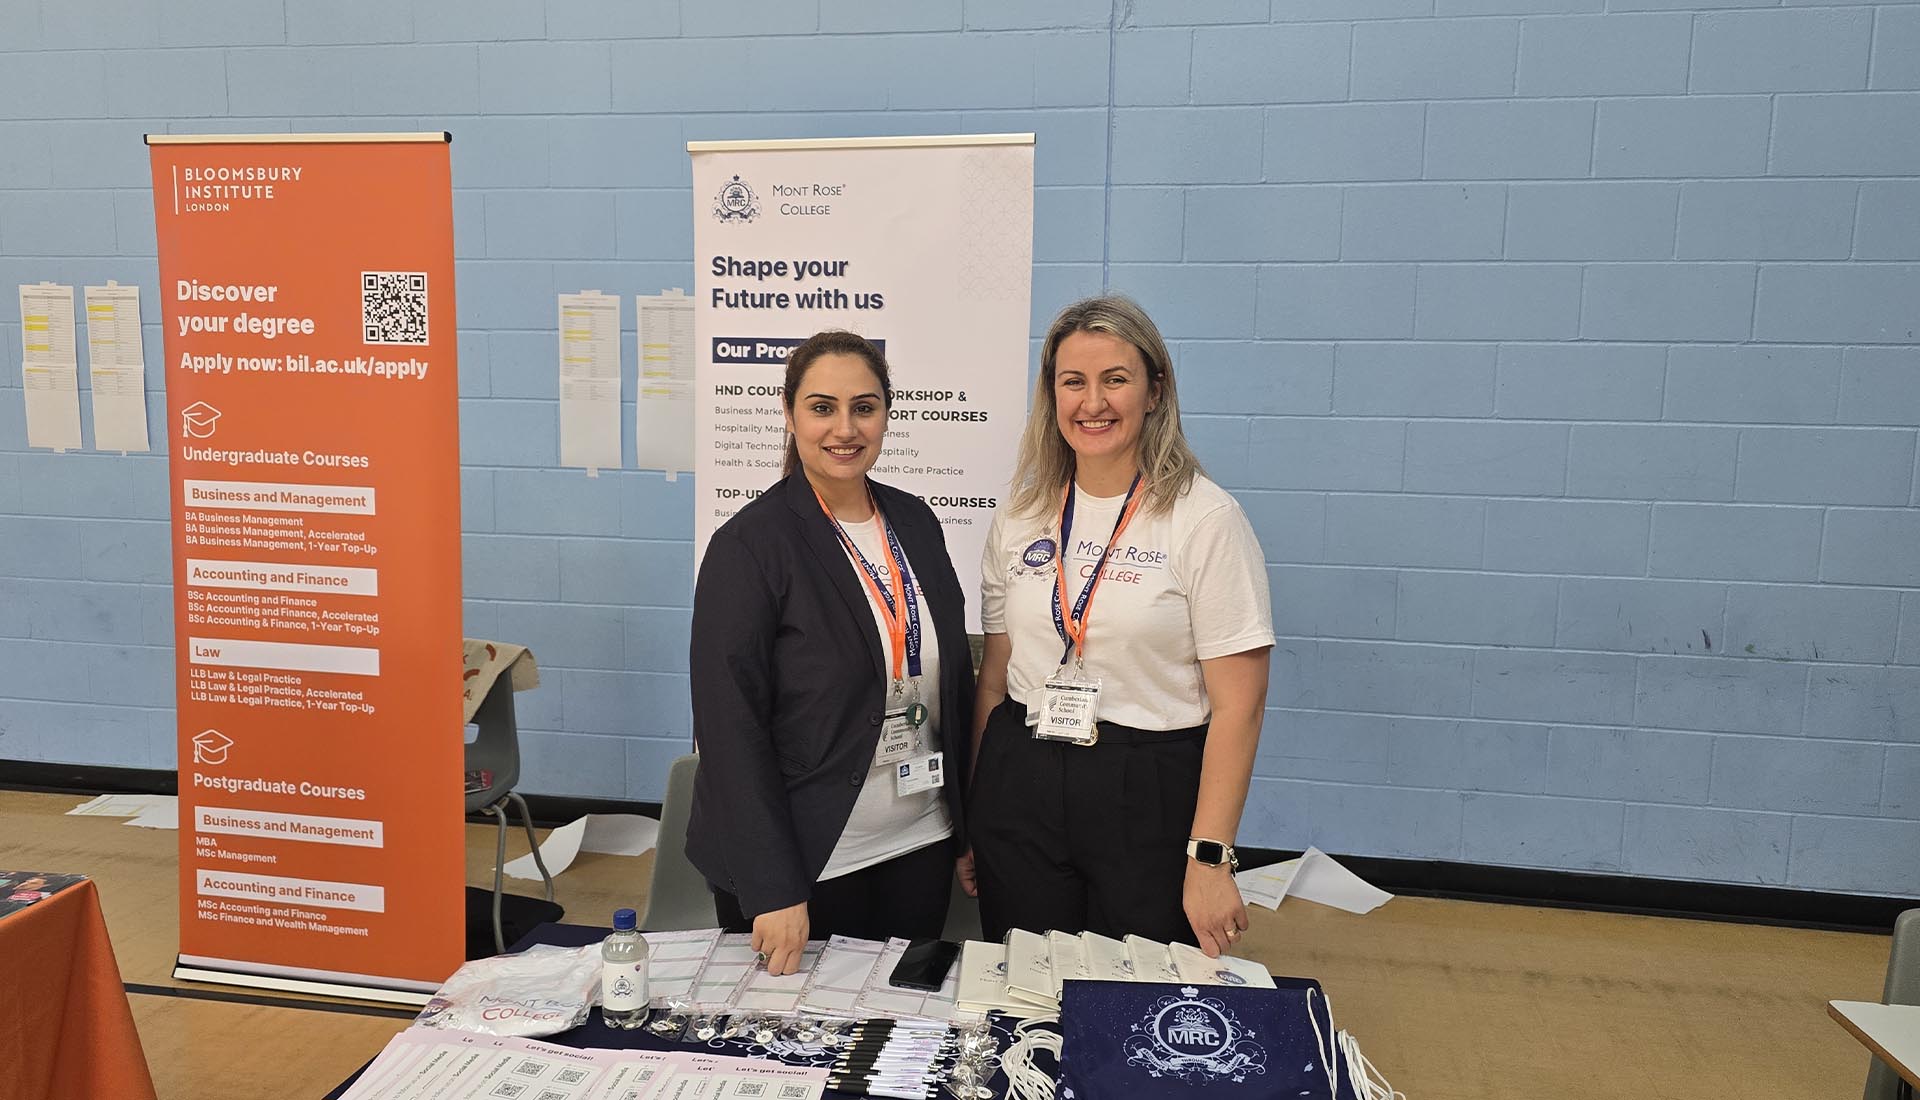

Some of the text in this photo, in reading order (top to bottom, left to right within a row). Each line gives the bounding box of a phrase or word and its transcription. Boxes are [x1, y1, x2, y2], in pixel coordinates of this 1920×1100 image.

[185, 168, 302, 180] BLOOMSBURY
[186, 186, 273, 199] INSTITUTE
[186, 204, 229, 212] LONDON
[727, 199, 746, 207] MRC
[712, 256, 848, 281] Shape your
[177, 280, 277, 302] Discover
[712, 288, 884, 309] Future with us
[178, 312, 314, 338] your degree
[717, 343, 751, 357] Our
[181, 353, 427, 380] Apply now: bil.ac.uk/apply
[716, 385, 743, 395] HND
[958, 392, 966, 401] &
[922, 411, 987, 422] COURSES
[715, 424, 785, 434] Hospitality Man
[715, 441, 742, 450] Digital
[183, 447, 368, 467] Undergraduate Courses
[715, 459, 743, 467] Health
[755, 460, 782, 468] Social
[903, 466, 923, 474] Care
[927, 467, 964, 475] Practice
[192, 488, 366, 508] Business and Management
[930, 496, 996, 508] COURSES
[185, 512, 303, 527] BA Business Management
[186, 524, 364, 541] BA Business Management, Accelerated
[186, 535, 376, 555] BA Business Management, 1-Year Top-Up
[1024, 552, 1050, 563] MRC
[193, 568, 348, 586] Accounting and Finance
[1080, 565, 1142, 584] CLLEGE
[188, 591, 317, 606] BSc Accounting and Finance
[904, 584, 913, 603] MONT
[1076, 594, 1087, 610] ROSE
[188, 603, 378, 622] BSc Accounting and Finance, Accelerated
[189, 614, 379, 636] BSc Accounting & Finance, 1-Year Top-Up
[196, 646, 220, 658] Law
[190, 669, 301, 685] LLB Law & Legal Practice
[191, 680, 362, 700] LLB Law & Legal Practice, Accelerated
[191, 692, 374, 714] LLB Law & Legal Practice, 1-Year Top-Up
[1051, 717, 1082, 726] VISITOR
[885, 742, 908, 753] VISITOR
[194, 773, 365, 800] Postgraduate Courses
[203, 814, 374, 840] Business and Management
[196, 837, 217, 846] MBA
[196, 848, 276, 863] MSc Management
[204, 878, 355, 902] Accounting and Finance
[198, 900, 326, 921] MSc Accounting and Finance
[198, 911, 368, 936] MSc Finance and Wealth Management
[1168, 1028, 1219, 1046] MRC
[525, 1044, 594, 1061] Let's get social!
